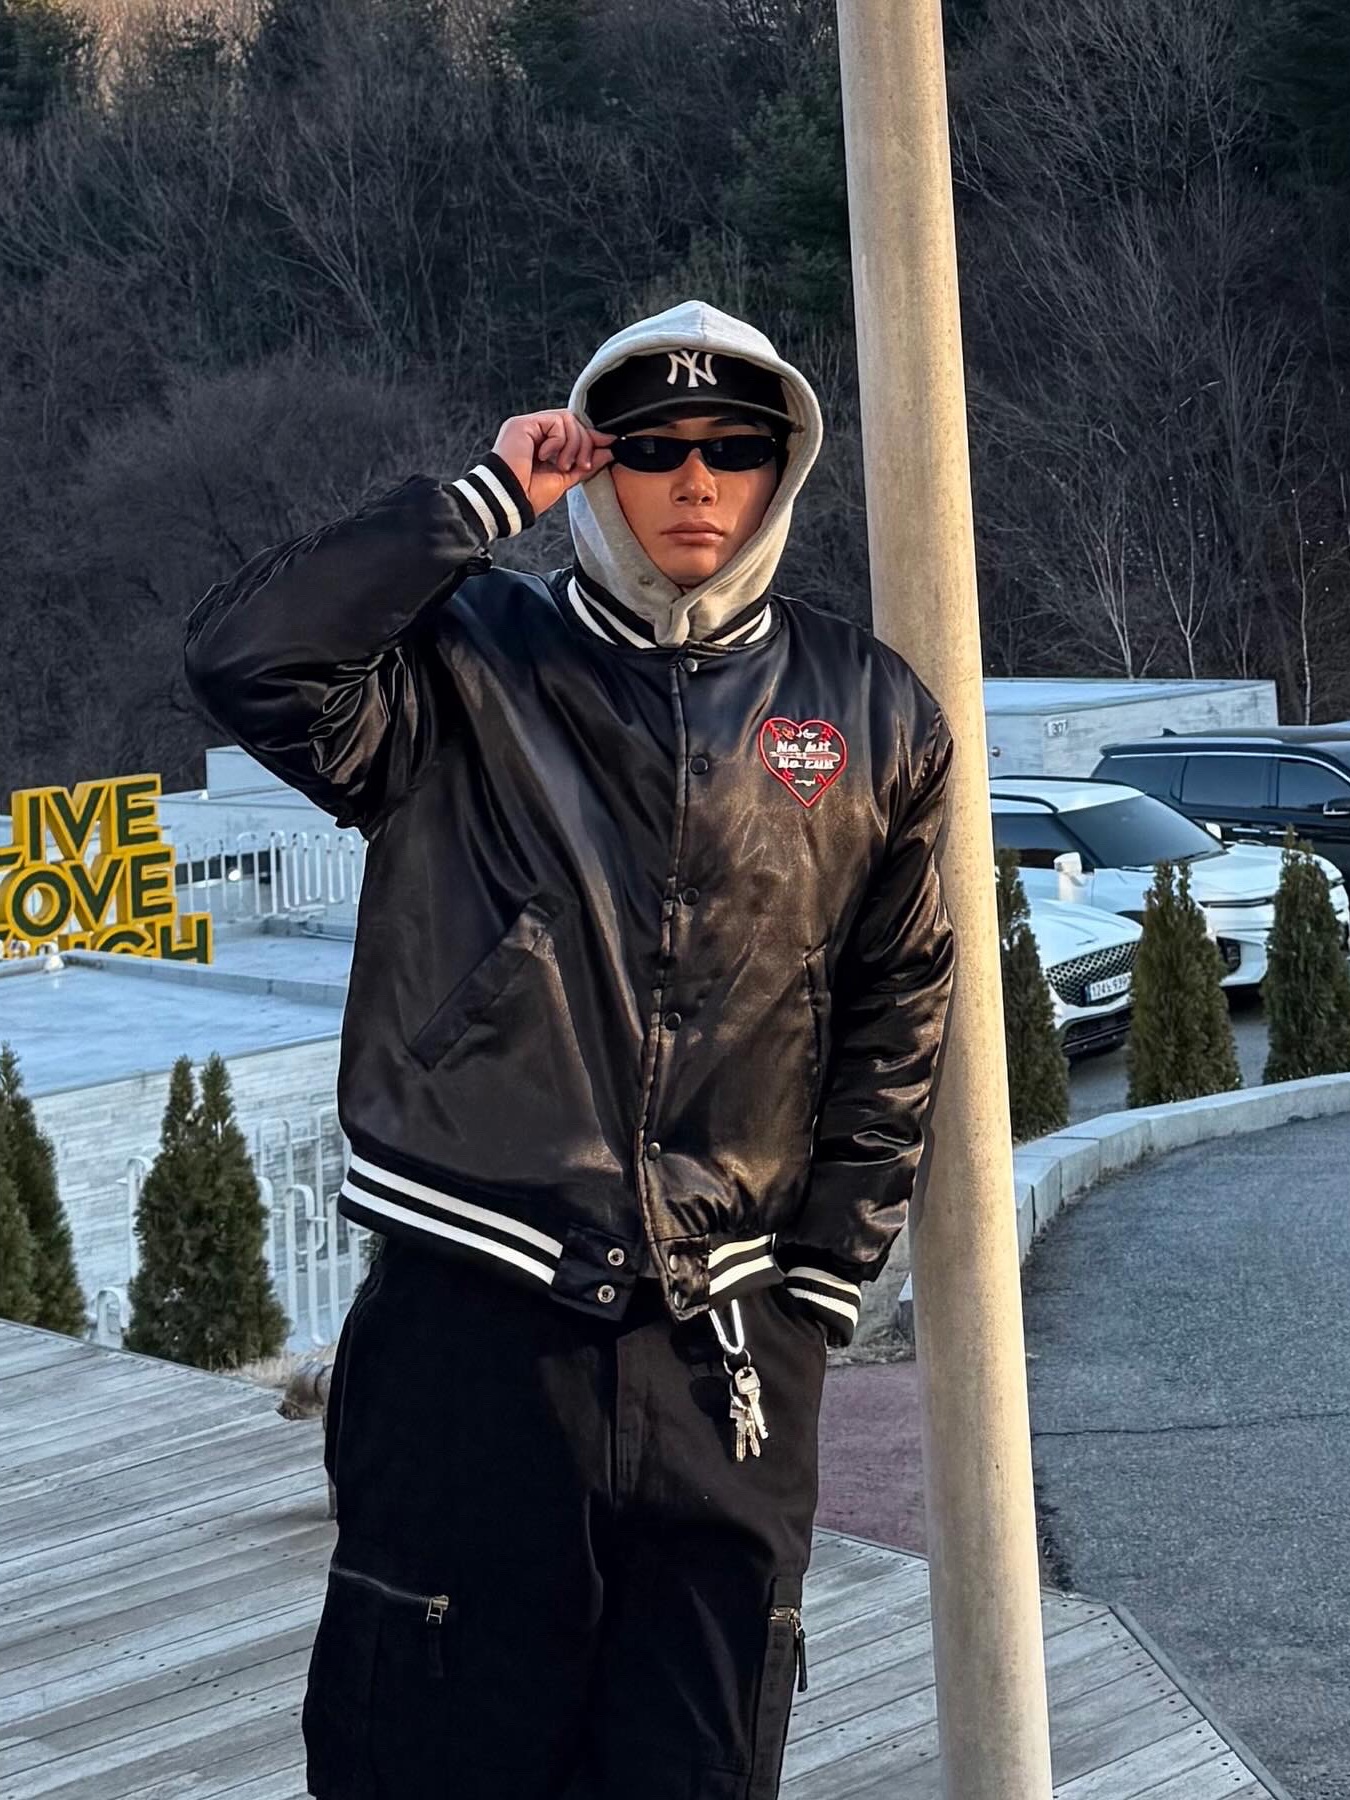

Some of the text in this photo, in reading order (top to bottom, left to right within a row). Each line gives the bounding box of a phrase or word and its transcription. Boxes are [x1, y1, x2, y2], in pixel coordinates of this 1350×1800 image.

[667, 350, 718, 388] NY
[0, 774, 162, 867] IVE
[0, 847, 175, 940] OVE
